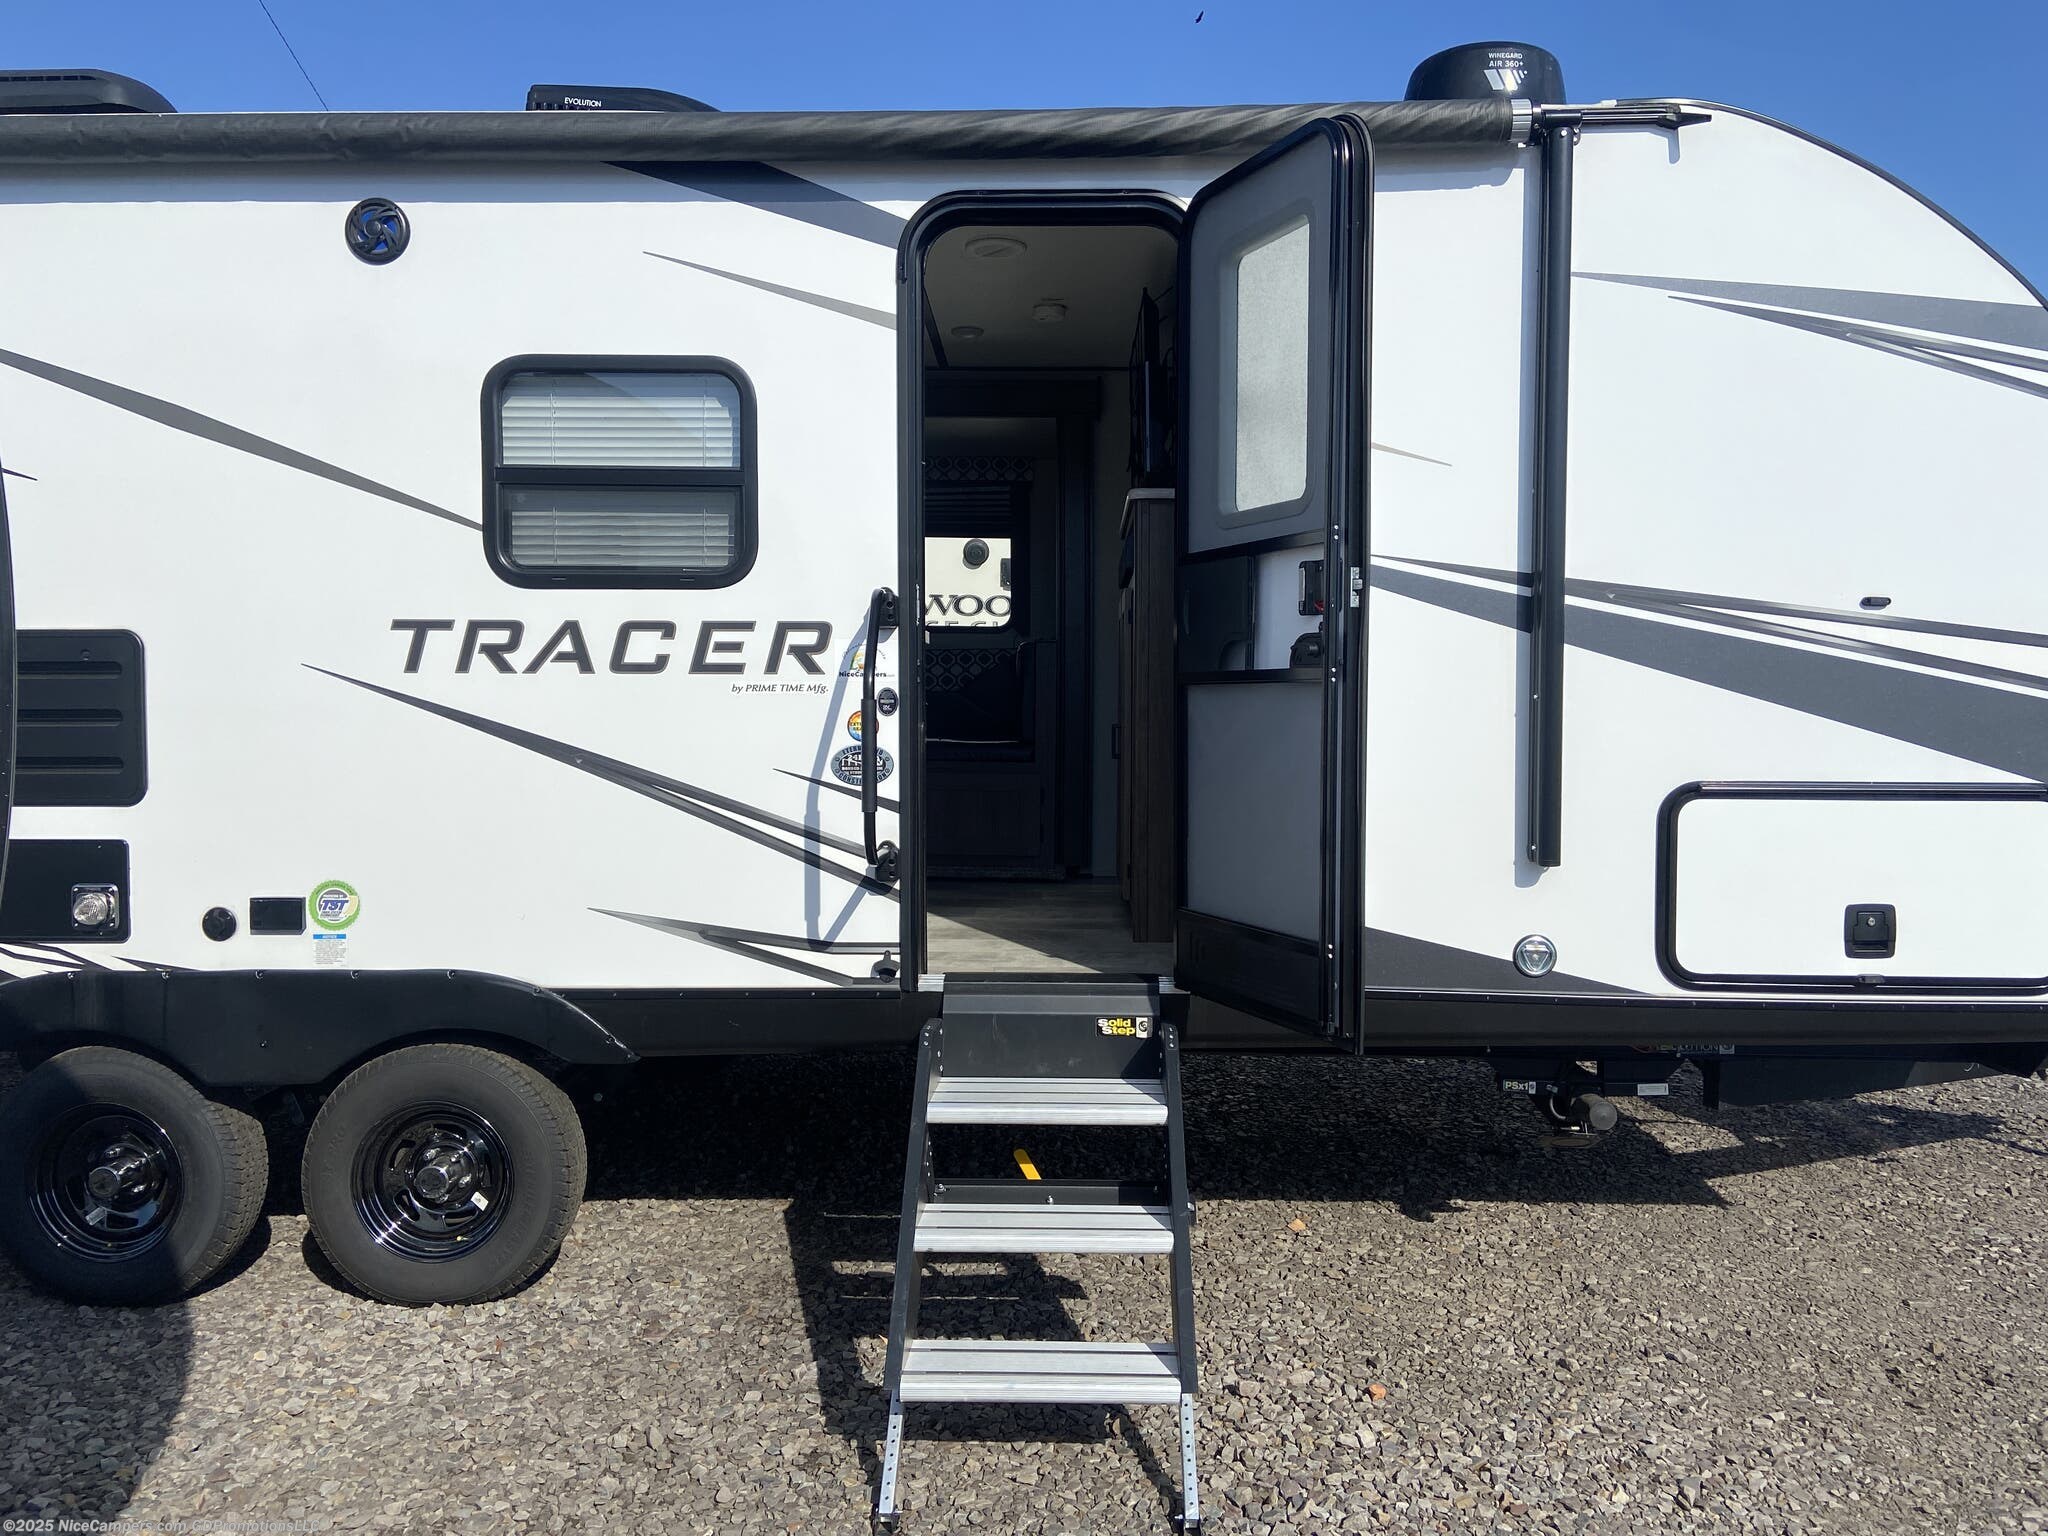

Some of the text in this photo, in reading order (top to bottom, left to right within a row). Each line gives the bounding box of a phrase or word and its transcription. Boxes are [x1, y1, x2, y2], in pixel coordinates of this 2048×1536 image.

[1504, 60, 1524, 68] 360+
[564, 96, 602, 107] EVOLUTION
[390, 618, 833, 675] TRACER
[731, 683, 829, 695] by PRIME TIME Mfg.
[321, 899, 349, 910] TST
[1097, 1018, 1132, 1027] Solid
[1101, 1026, 1136, 1036] Step
[1505, 1081, 1529, 1090] PSx1
